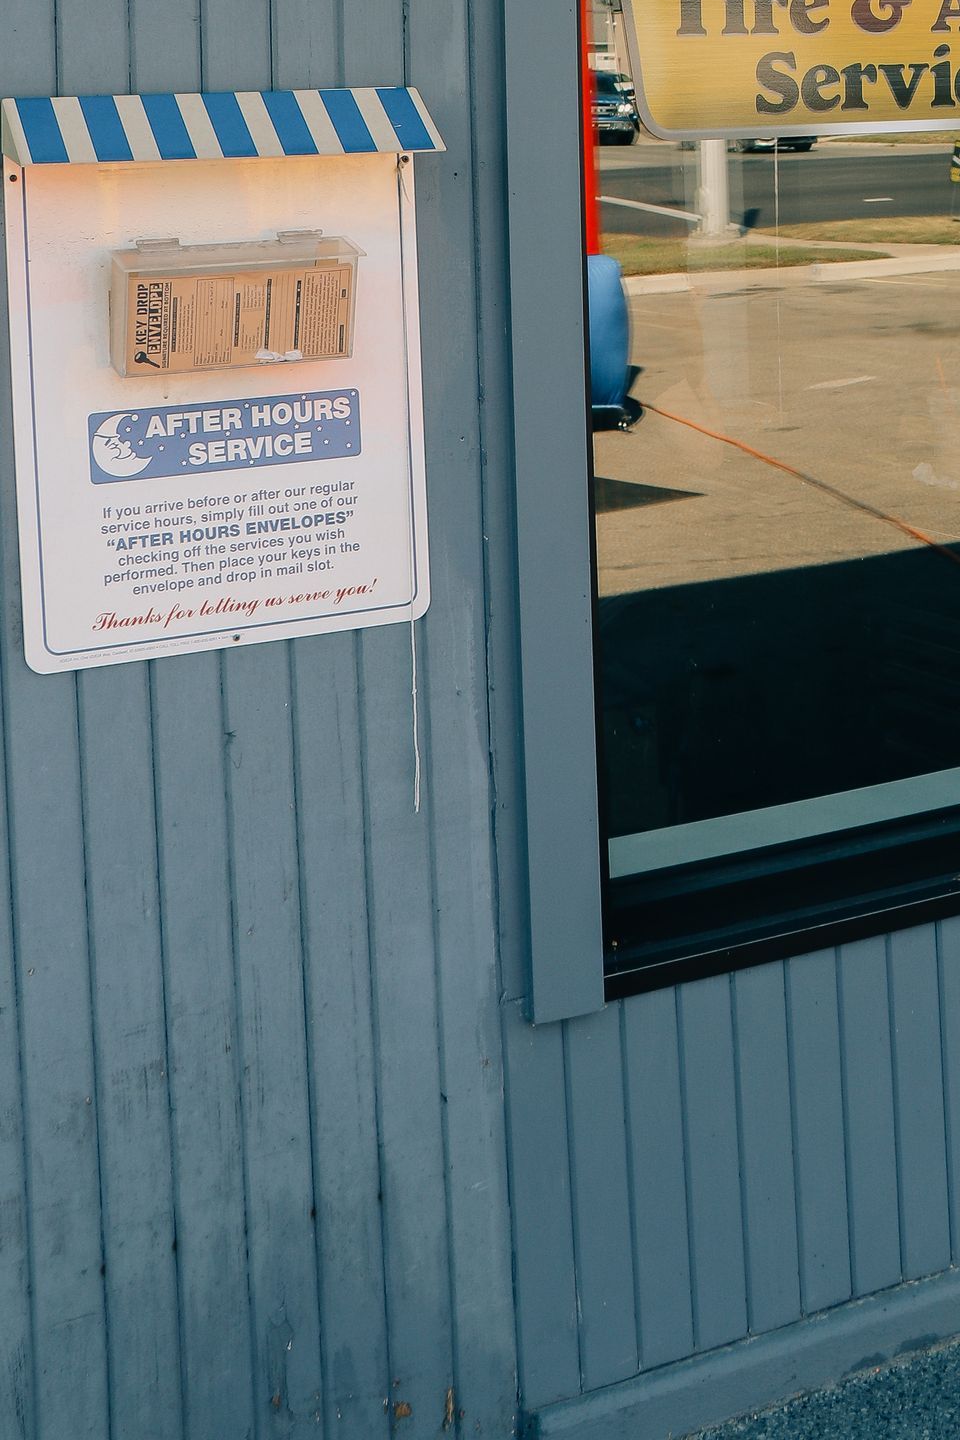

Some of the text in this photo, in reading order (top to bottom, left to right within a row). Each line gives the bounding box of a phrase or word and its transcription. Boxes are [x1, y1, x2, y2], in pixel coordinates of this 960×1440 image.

[136, 284, 148, 345] KEY DROP
[148, 283, 162, 353] ENVELOPE
[145, 397, 351, 438] AFTER HOURS
[188, 431, 312, 466] SERVICE
[101, 495, 358, 534] service hours, simply fill out one of our
[103, 481, 355, 521] If you arrive before or after our regular
[107, 511, 354, 551] “AFTER HOURS ENVELOPES”
[118, 528, 345, 567] checking off the services you wish
[104, 542, 360, 586] performed. Then place your keys in the
[133, 559, 334, 595] envelope and drop in mail slot.
[92, 578, 378, 631] Thanks for letting us serve you!
